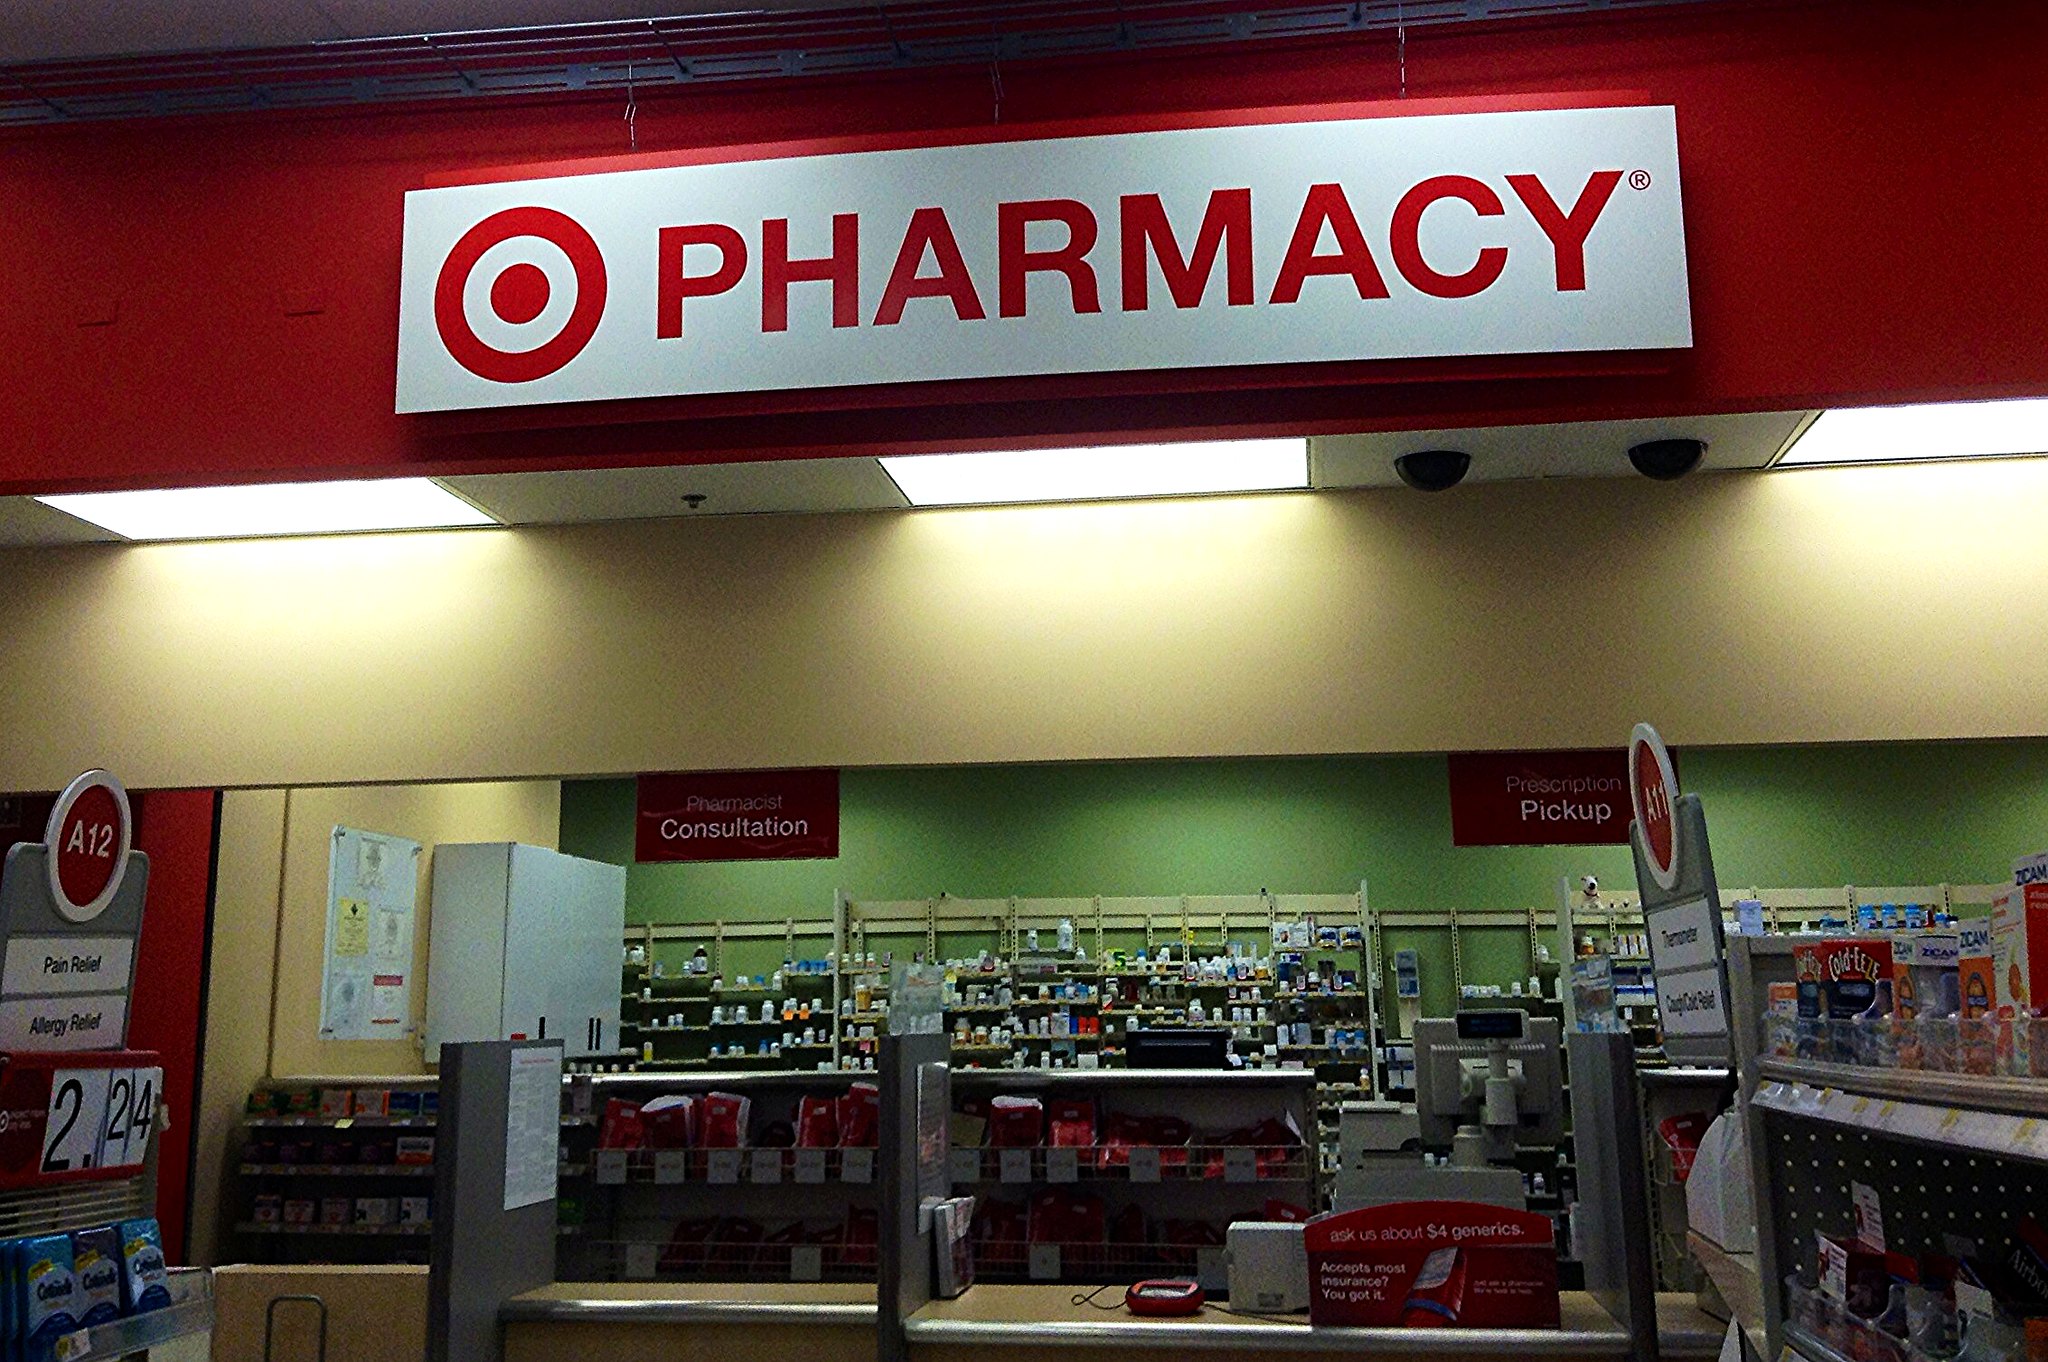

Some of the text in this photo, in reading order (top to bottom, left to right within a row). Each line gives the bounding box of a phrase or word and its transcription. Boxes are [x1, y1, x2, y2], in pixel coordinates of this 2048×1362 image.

[657, 170, 1624, 340] PHARMACY
[1506, 775, 1622, 795] Prescription
[686, 795, 782, 813] Pharmacist
[1521, 799, 1612, 824] Pickup
[1645, 779, 1669, 824] A11
[660, 816, 808, 840] Consultation
[66, 820, 114, 858] A12
[1959, 930, 1989, 949] ZICAM
[44, 955, 102, 974] Pain Relief
[29, 1012, 103, 1038] Allergy Relief
[1330, 1222, 1525, 1242] ask us about $4 generics.
[1320, 1261, 1406, 1275] Accepts most
[1321, 1275, 1389, 1288] insurance?
[1321, 1288, 1345, 1300] You
[1349, 1289, 1370, 1302] got
